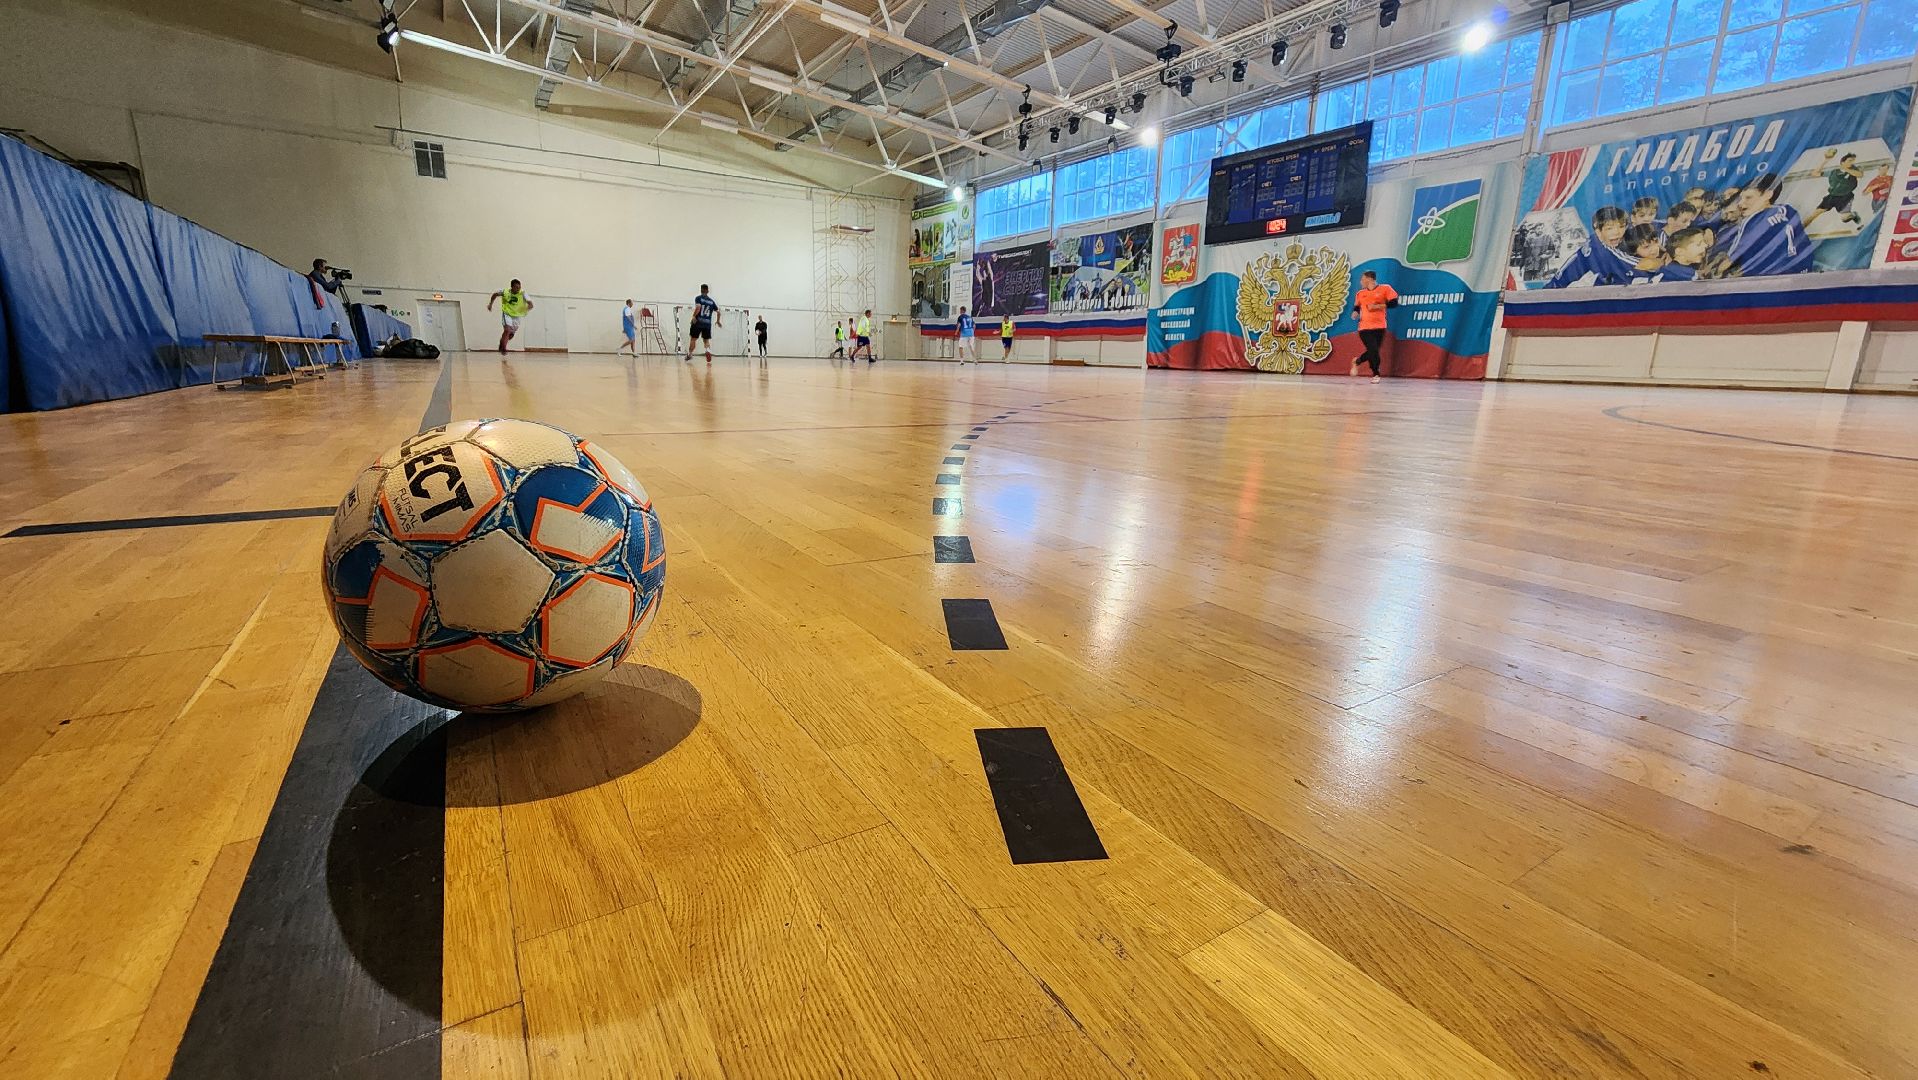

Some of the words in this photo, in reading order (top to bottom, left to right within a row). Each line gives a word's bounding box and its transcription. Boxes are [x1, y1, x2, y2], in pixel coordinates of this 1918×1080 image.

[1607, 119, 1785, 177] ГАНДБОЛ
[1603, 184, 1613, 194] В
[1627, 161, 1769, 191] ПРОТВИНО
[1005, 266, 1045, 283] ЭНЕРГИЯ
[1413, 310, 1443, 322] ГОРОДА
[1406, 328, 1447, 339] ПРОТВИНО
[392, 496, 412, 533] MIMAS
[399, 487, 419, 529] FUTSAL
